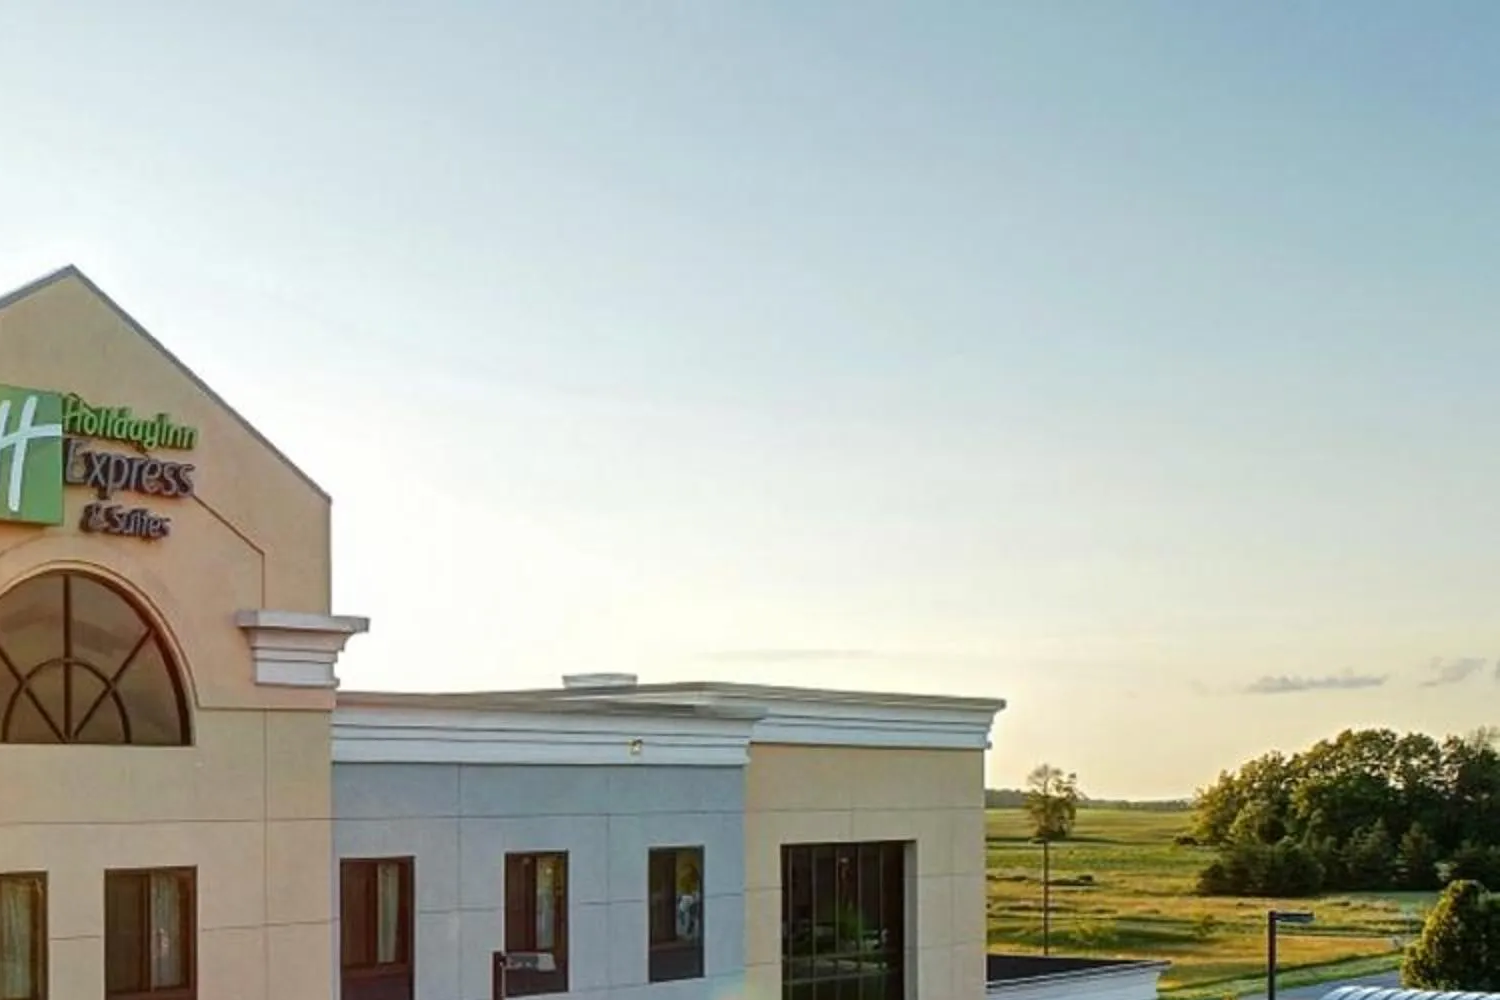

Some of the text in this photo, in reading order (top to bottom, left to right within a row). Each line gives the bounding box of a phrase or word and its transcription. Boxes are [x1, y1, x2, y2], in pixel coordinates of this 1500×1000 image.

[63, 393, 198, 450] Holiday Inn
[63, 437, 196, 501] Express
[103, 504, 172, 540] Suites
